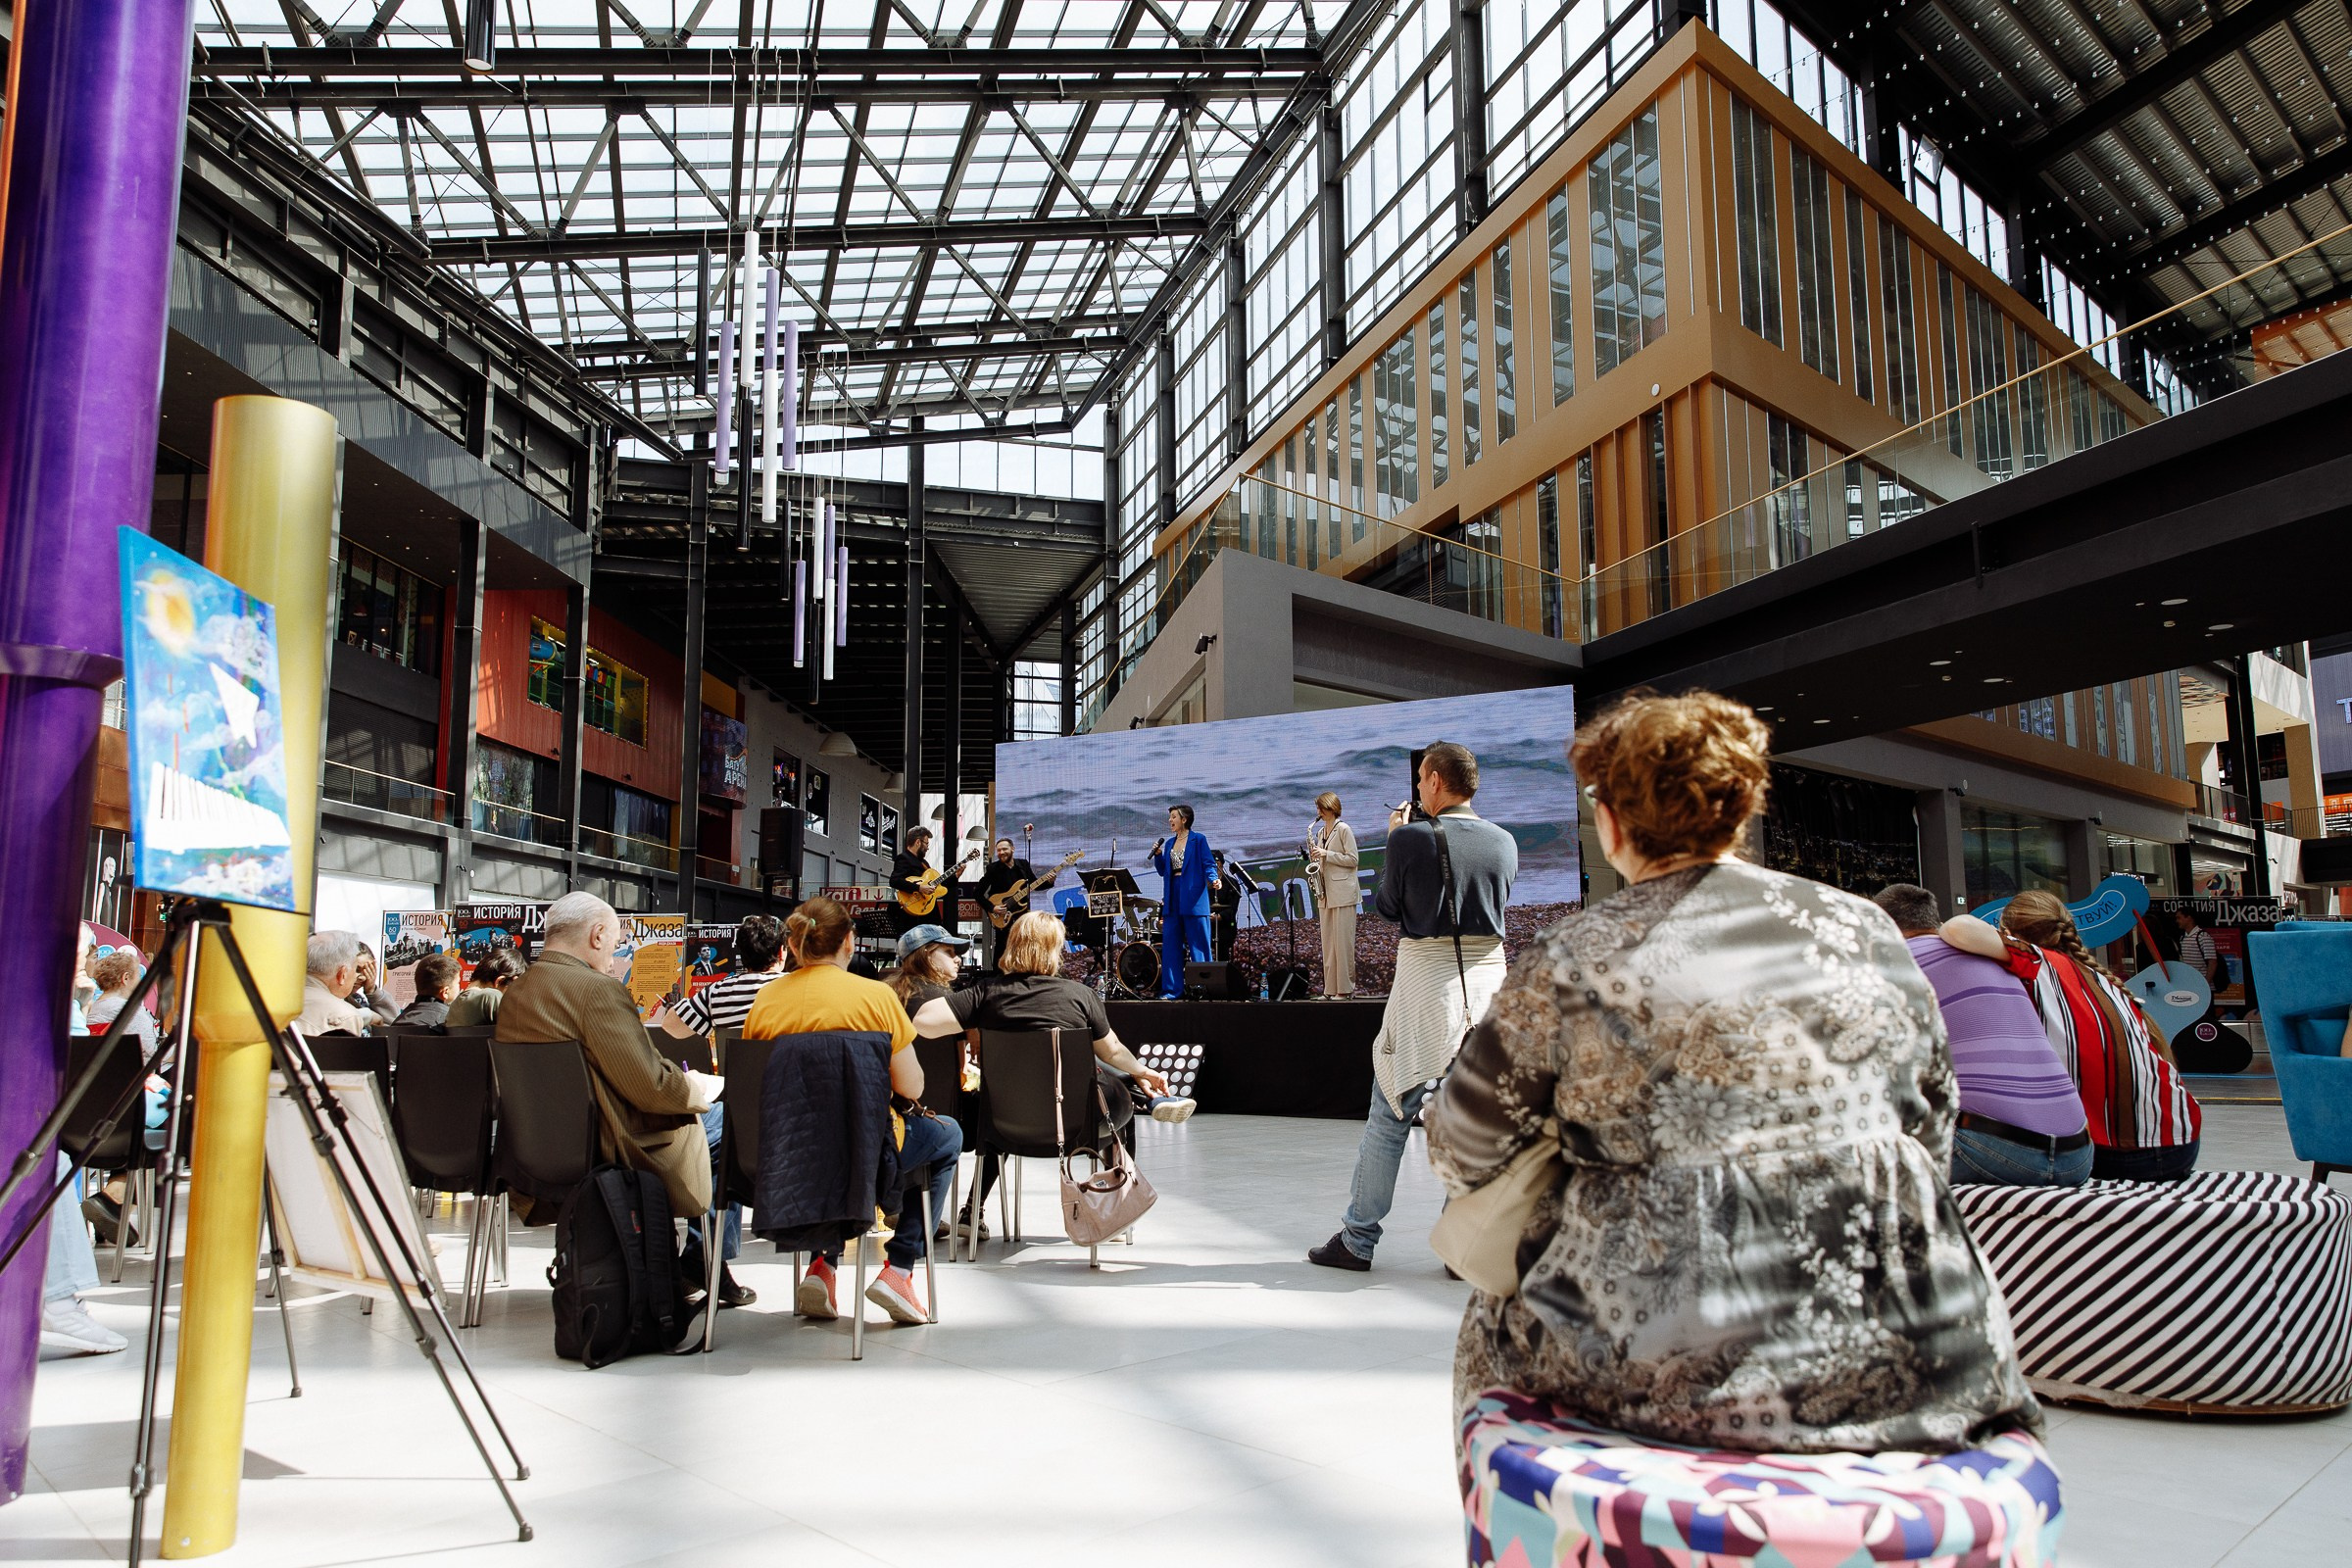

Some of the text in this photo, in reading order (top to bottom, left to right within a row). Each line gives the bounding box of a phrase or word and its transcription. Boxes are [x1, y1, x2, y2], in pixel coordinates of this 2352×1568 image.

[473, 906, 521, 919] ИСТОРИЯ
[2215, 900, 2280, 926] Джаза
[402, 914, 443, 926] ИСТОРИЯ
[632, 919, 683, 941] Джаза
[699, 929, 732, 939] ИСТОРИЯ
